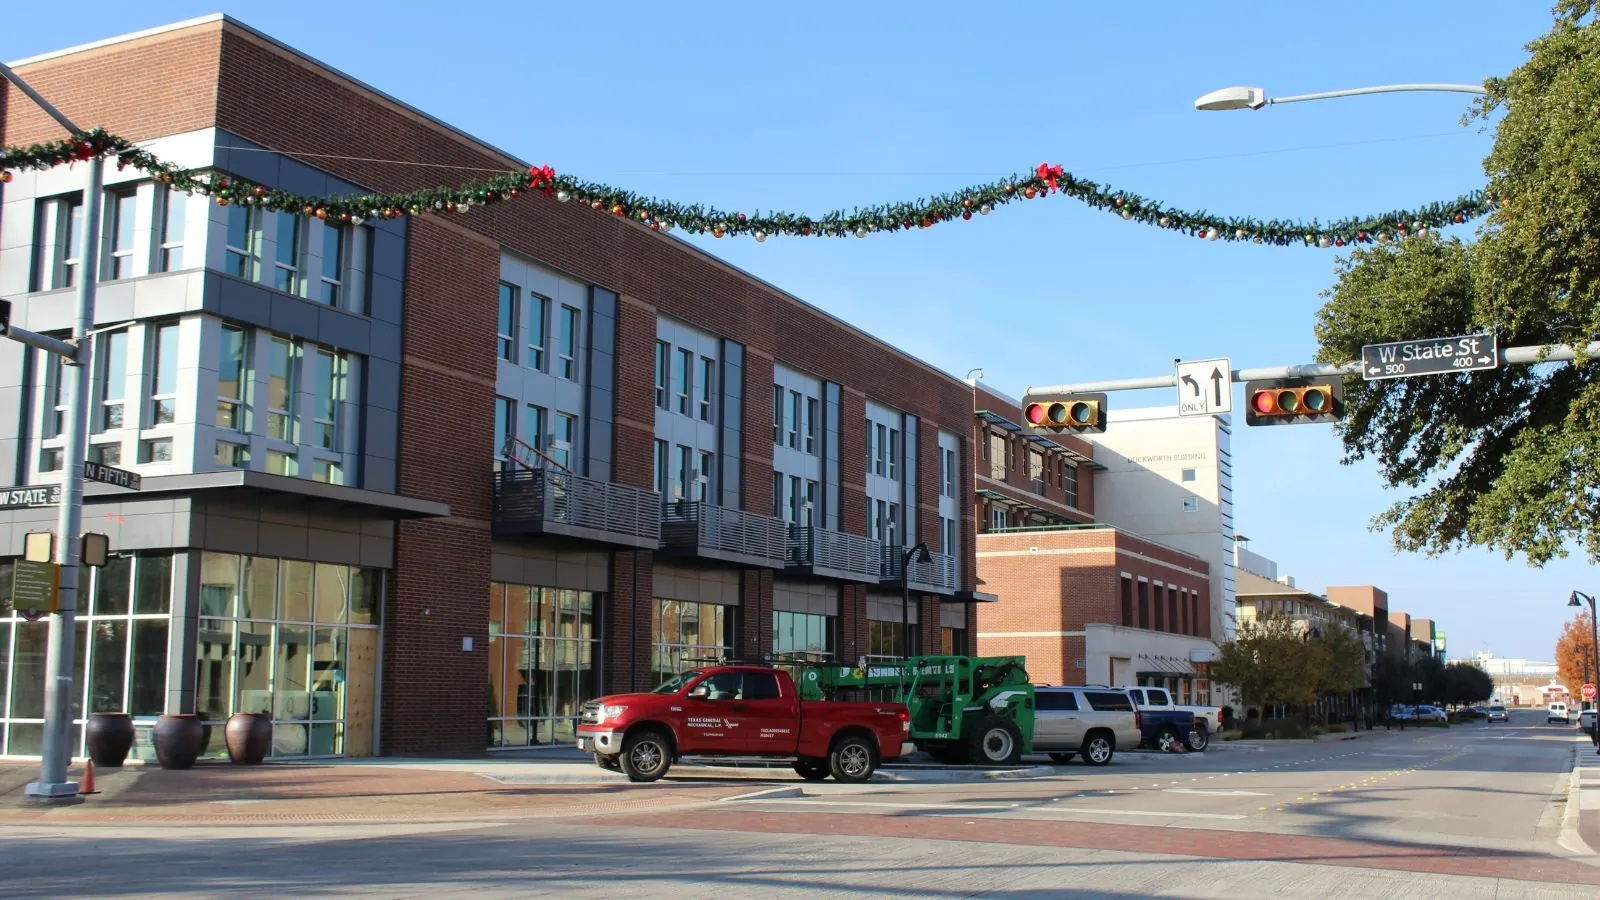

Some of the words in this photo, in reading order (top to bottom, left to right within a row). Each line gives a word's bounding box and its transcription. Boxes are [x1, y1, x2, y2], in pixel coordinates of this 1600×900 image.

[1378, 346, 1397, 363] W
[1403, 342, 1453, 361] State
[1459, 339, 1480, 356] St
[1385, 363, 1406, 374] 500
[1452, 357, 1473, 368] 400
[1181, 402, 1205, 412] ONLY
[1127, 454, 1172, 464] DUCKWORTH
[1174, 452, 1206, 461] BUILDING
[86, 465, 95, 477] N
[98, 467, 128, 485] FIFTH
[11, 489, 47, 504] STATE
